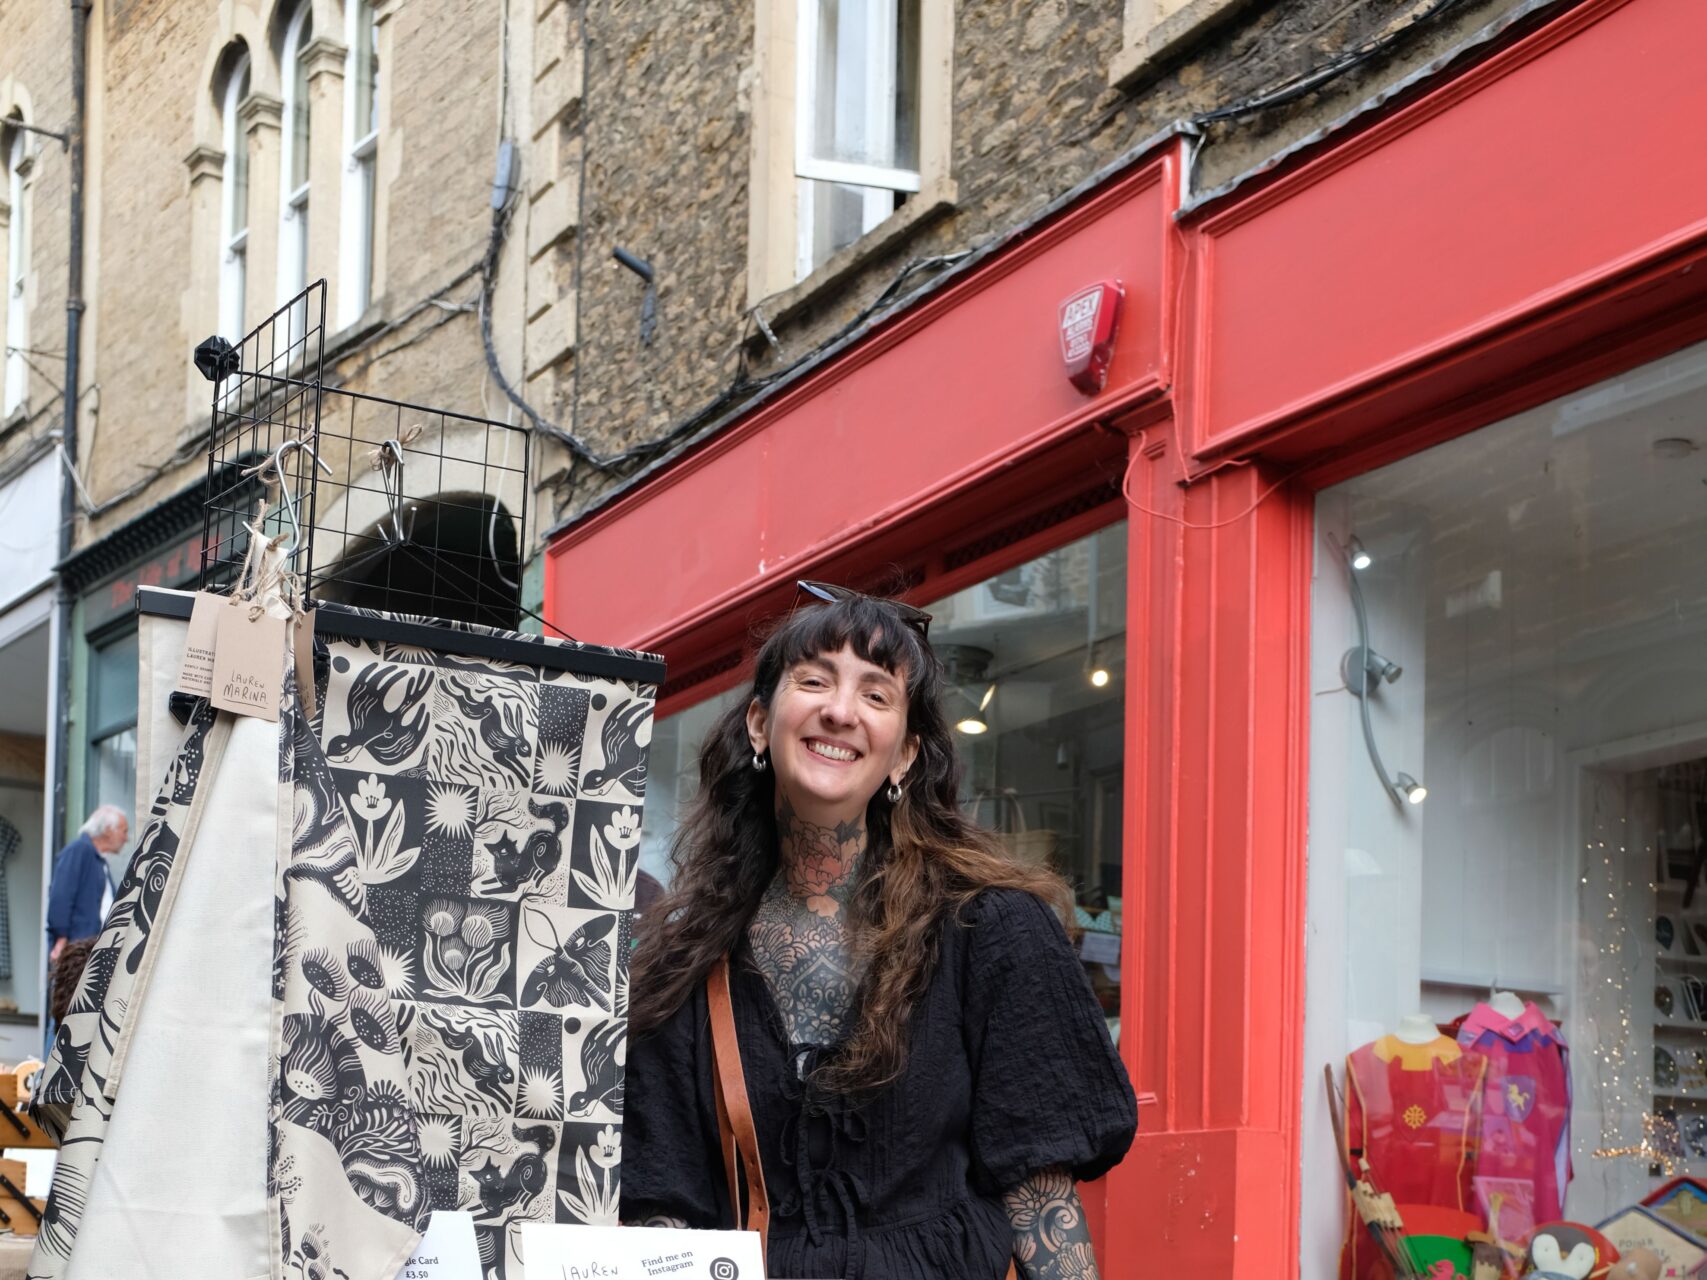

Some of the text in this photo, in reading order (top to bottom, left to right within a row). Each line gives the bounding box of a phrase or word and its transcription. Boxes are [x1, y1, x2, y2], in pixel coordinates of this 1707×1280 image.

[231, 670, 265, 689] LAUREN
[418, 1256, 439, 1265] Card
[641, 1250, 694, 1268] Find me on
[406, 1270, 428, 1279] £3.50
[647, 1260, 694, 1276] Instagram
